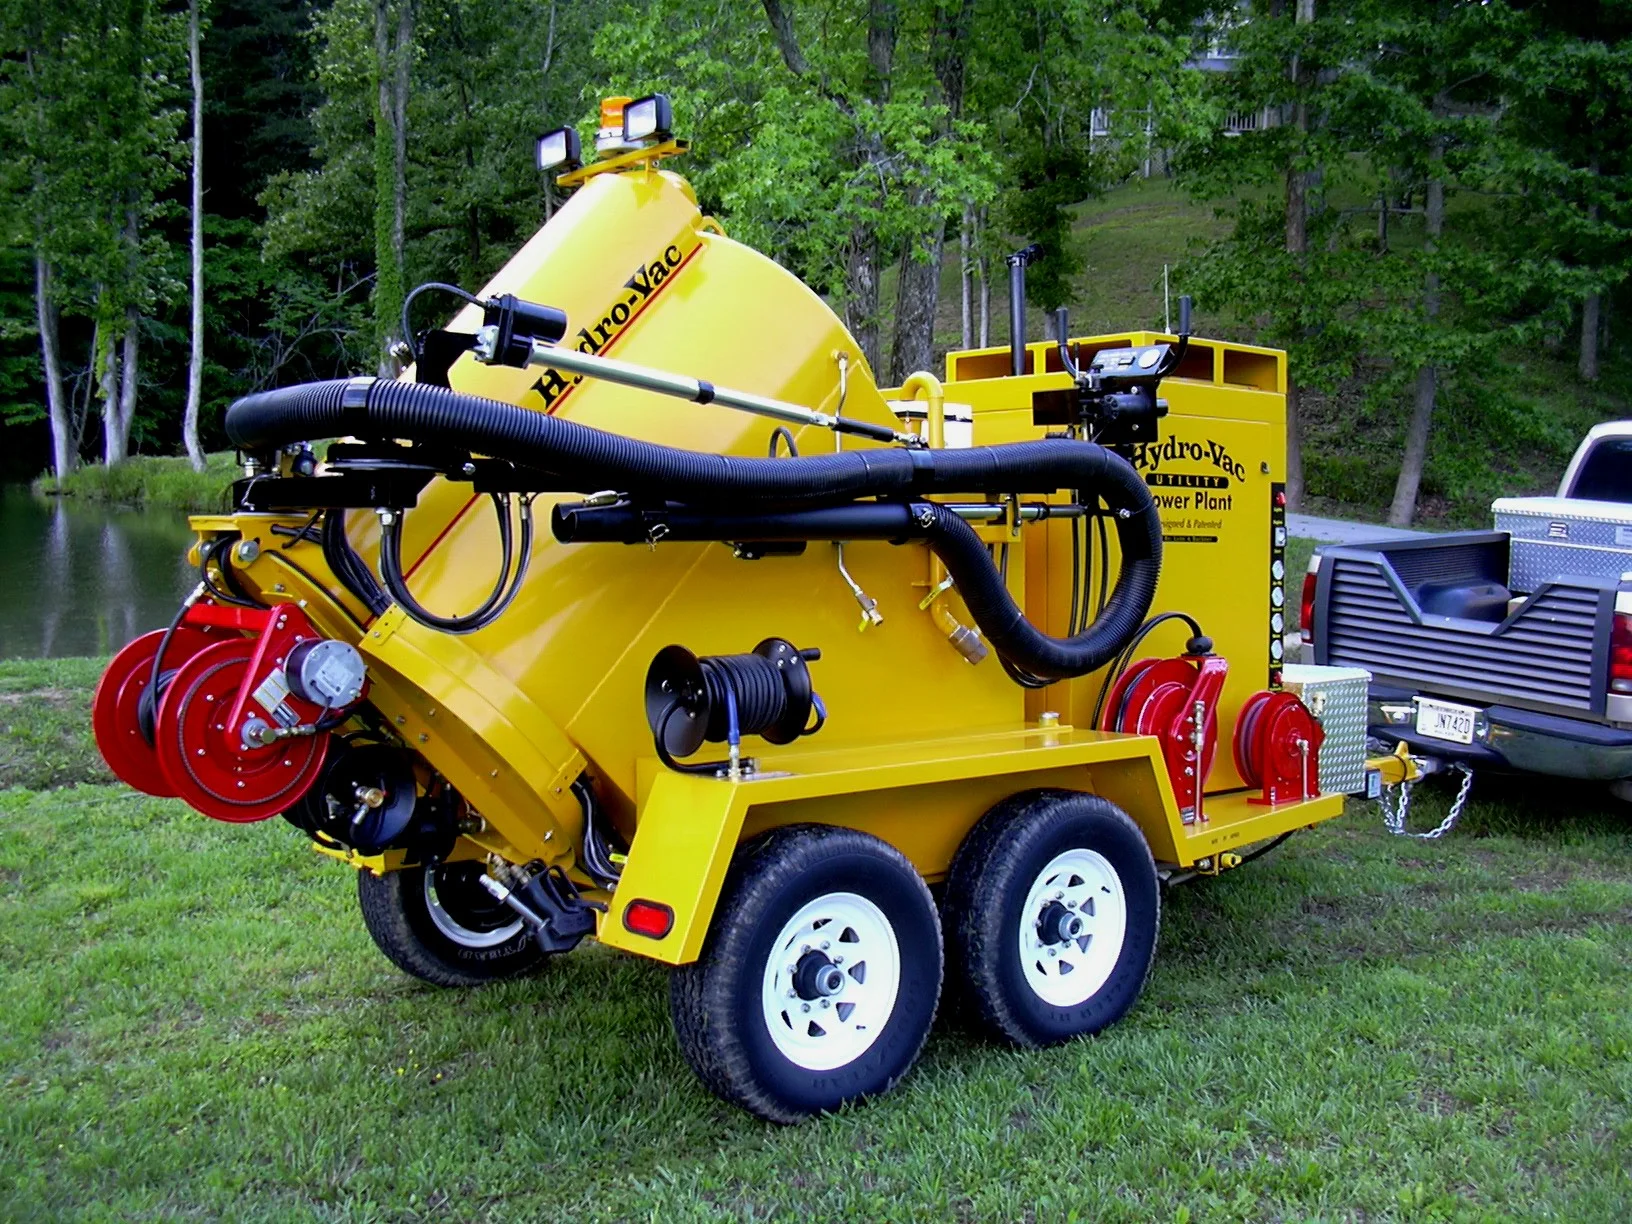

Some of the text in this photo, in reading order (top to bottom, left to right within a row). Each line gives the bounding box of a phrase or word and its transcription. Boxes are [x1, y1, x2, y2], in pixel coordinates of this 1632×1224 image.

[1131, 434, 1245, 482] Hydro-Vac
[1156, 474, 1219, 487] UTILITY
[1152, 491, 1233, 511] ower Plant
